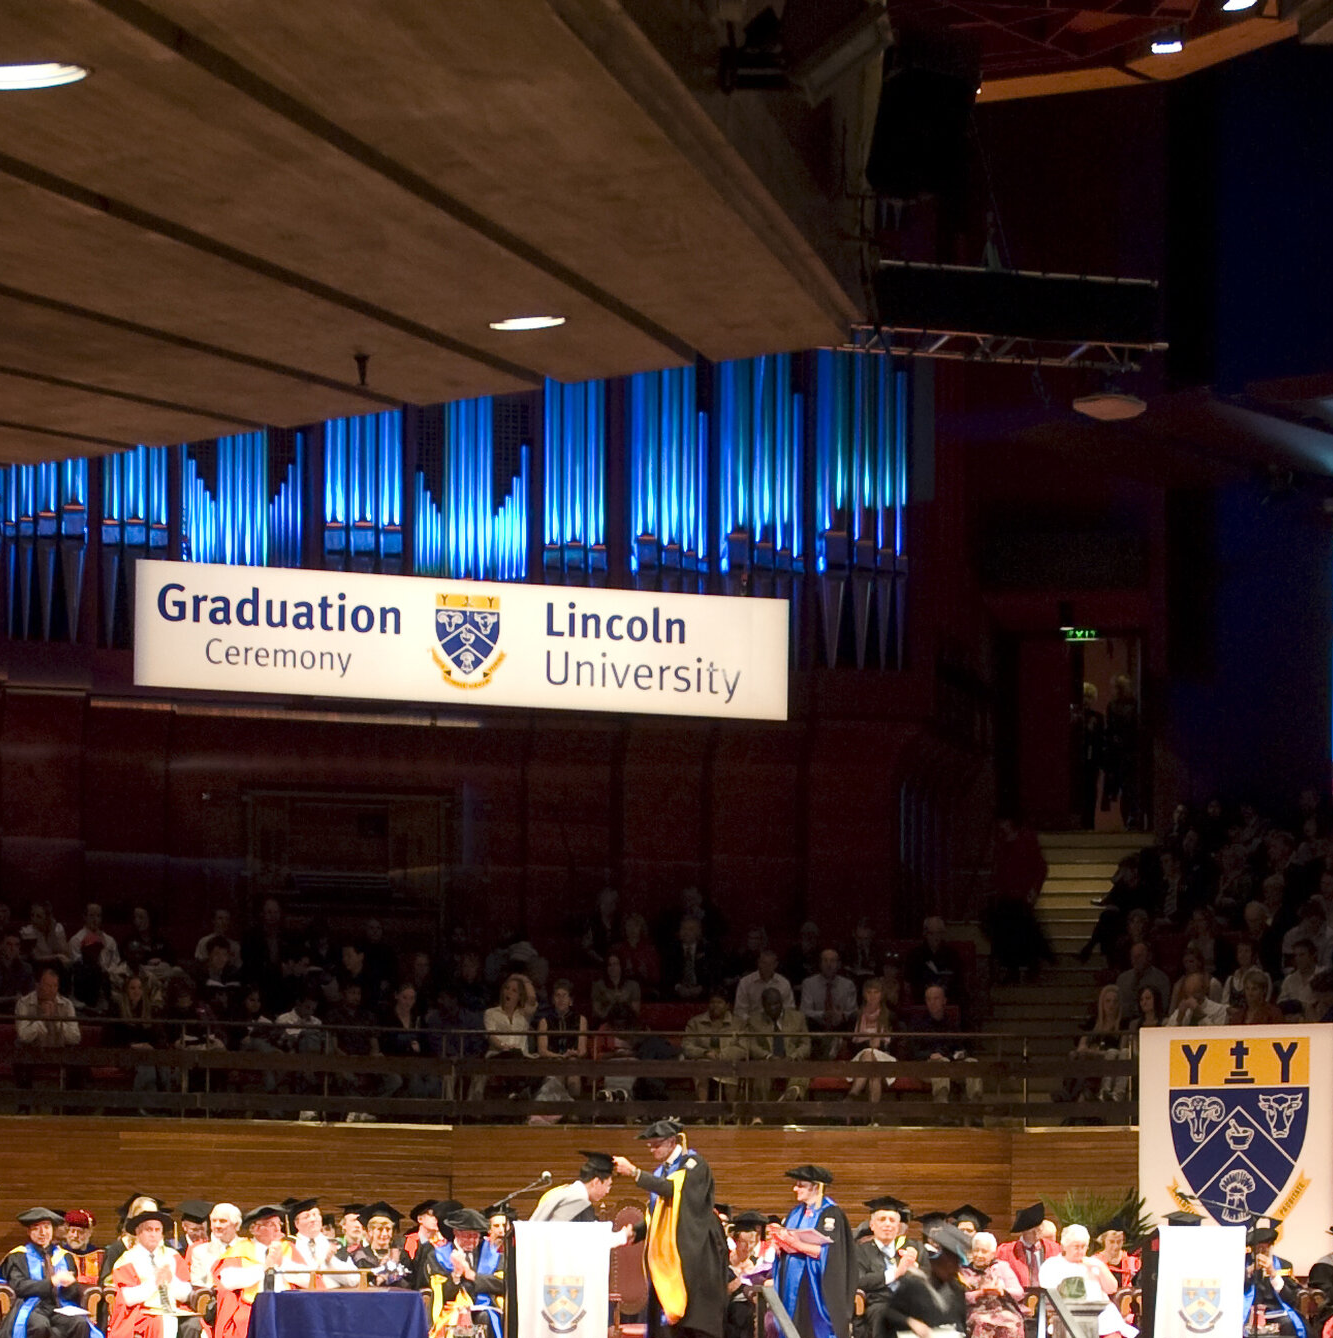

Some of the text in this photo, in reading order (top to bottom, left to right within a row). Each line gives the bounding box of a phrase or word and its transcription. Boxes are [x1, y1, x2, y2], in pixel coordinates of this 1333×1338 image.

[157, 582, 401, 635] Graduation
[546, 602, 686, 645] Lincoln
[205, 638, 352, 678] Ceremony
[546, 650, 742, 705] University
